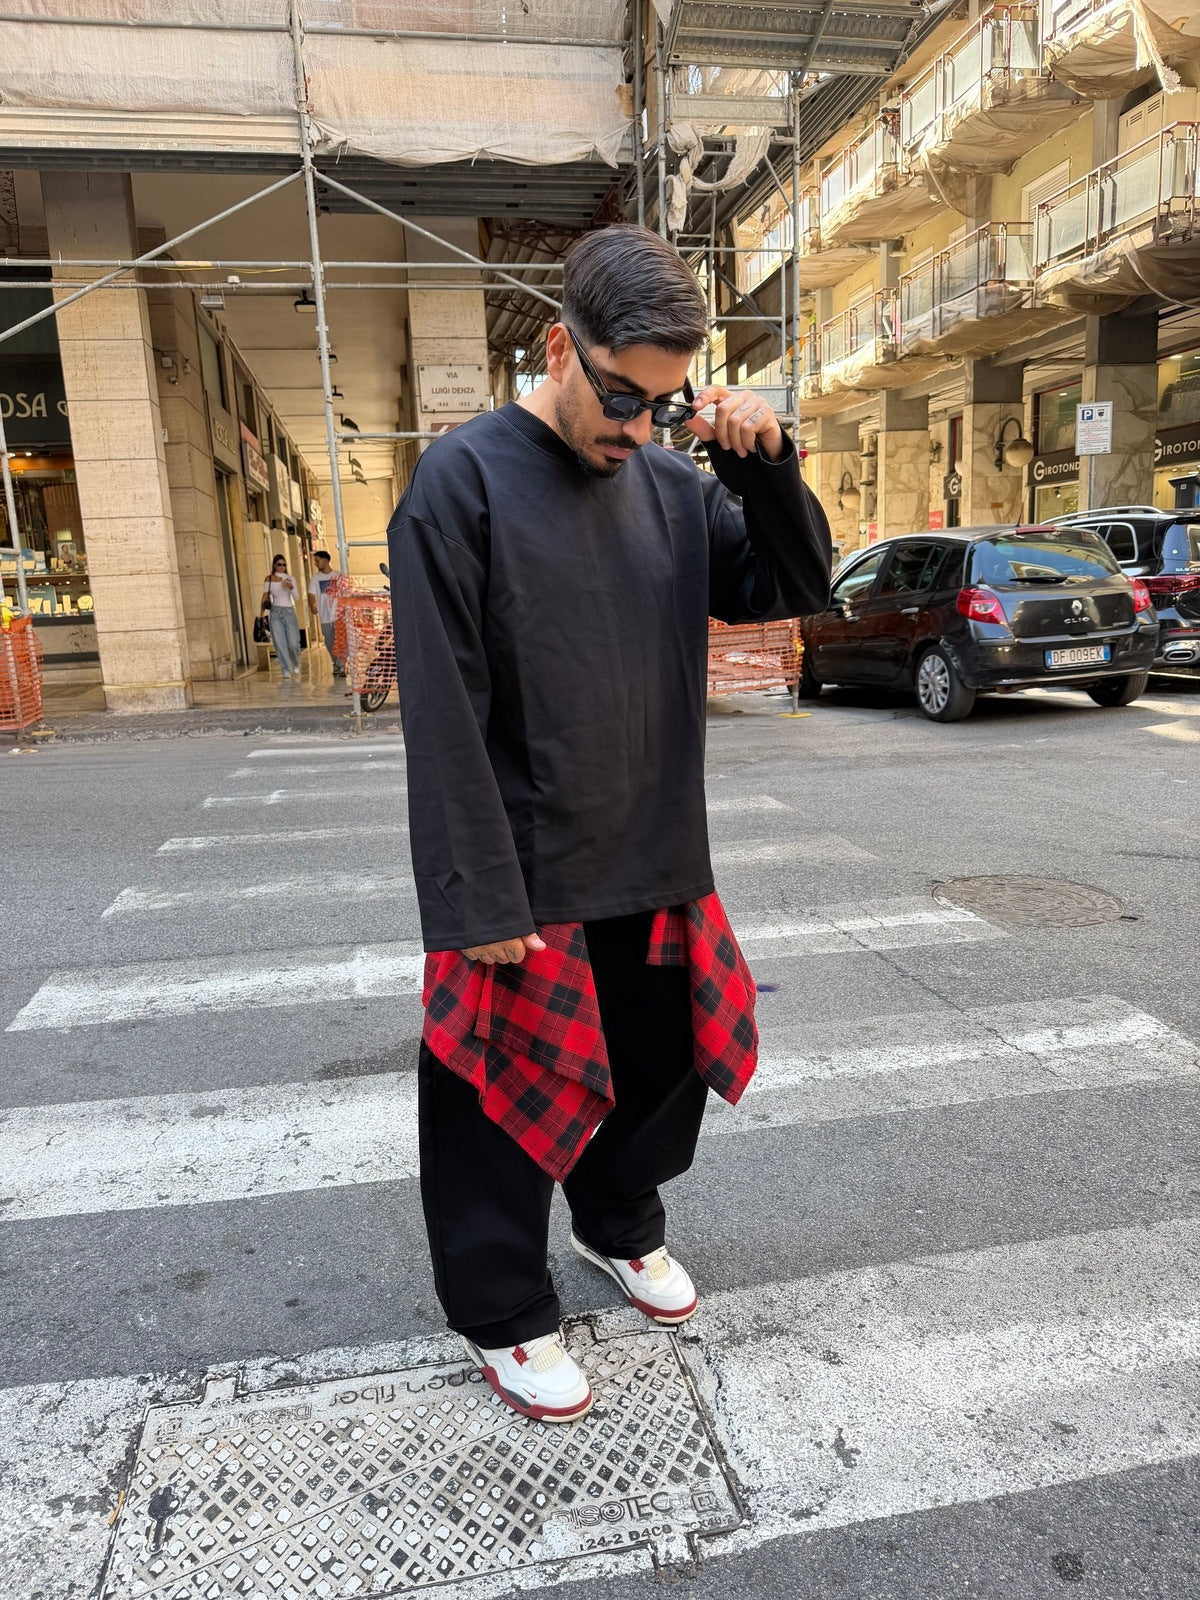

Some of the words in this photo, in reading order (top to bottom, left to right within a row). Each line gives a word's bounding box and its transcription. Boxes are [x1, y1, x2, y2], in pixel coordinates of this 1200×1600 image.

[1064, 616, 1090, 624] CLIO
[1053, 650, 1066, 663] DF
[407, 1368, 486, 1393] open
[329, 1384, 397, 1407] fiber
